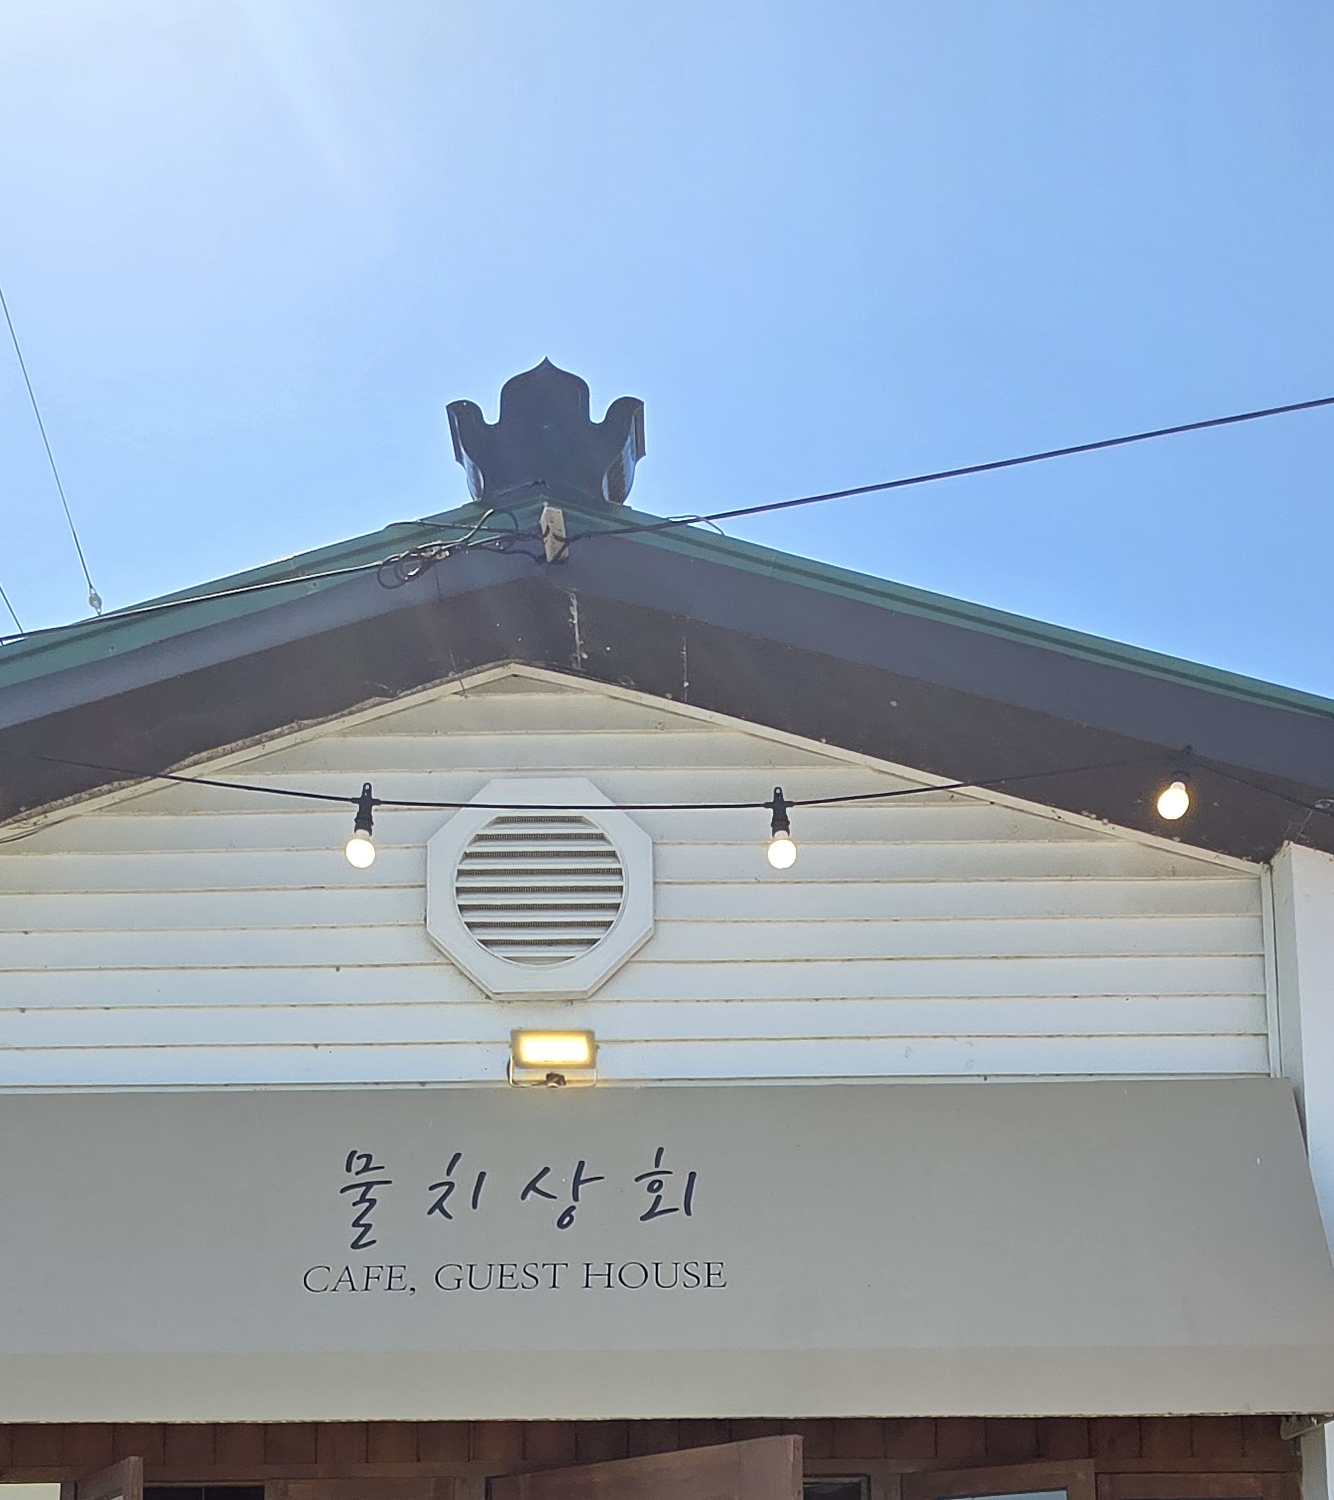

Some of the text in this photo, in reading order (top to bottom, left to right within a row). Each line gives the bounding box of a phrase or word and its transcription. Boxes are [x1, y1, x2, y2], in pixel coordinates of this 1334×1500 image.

[302, 1261, 728, 1297] CAFE, GUEST HOUSE
